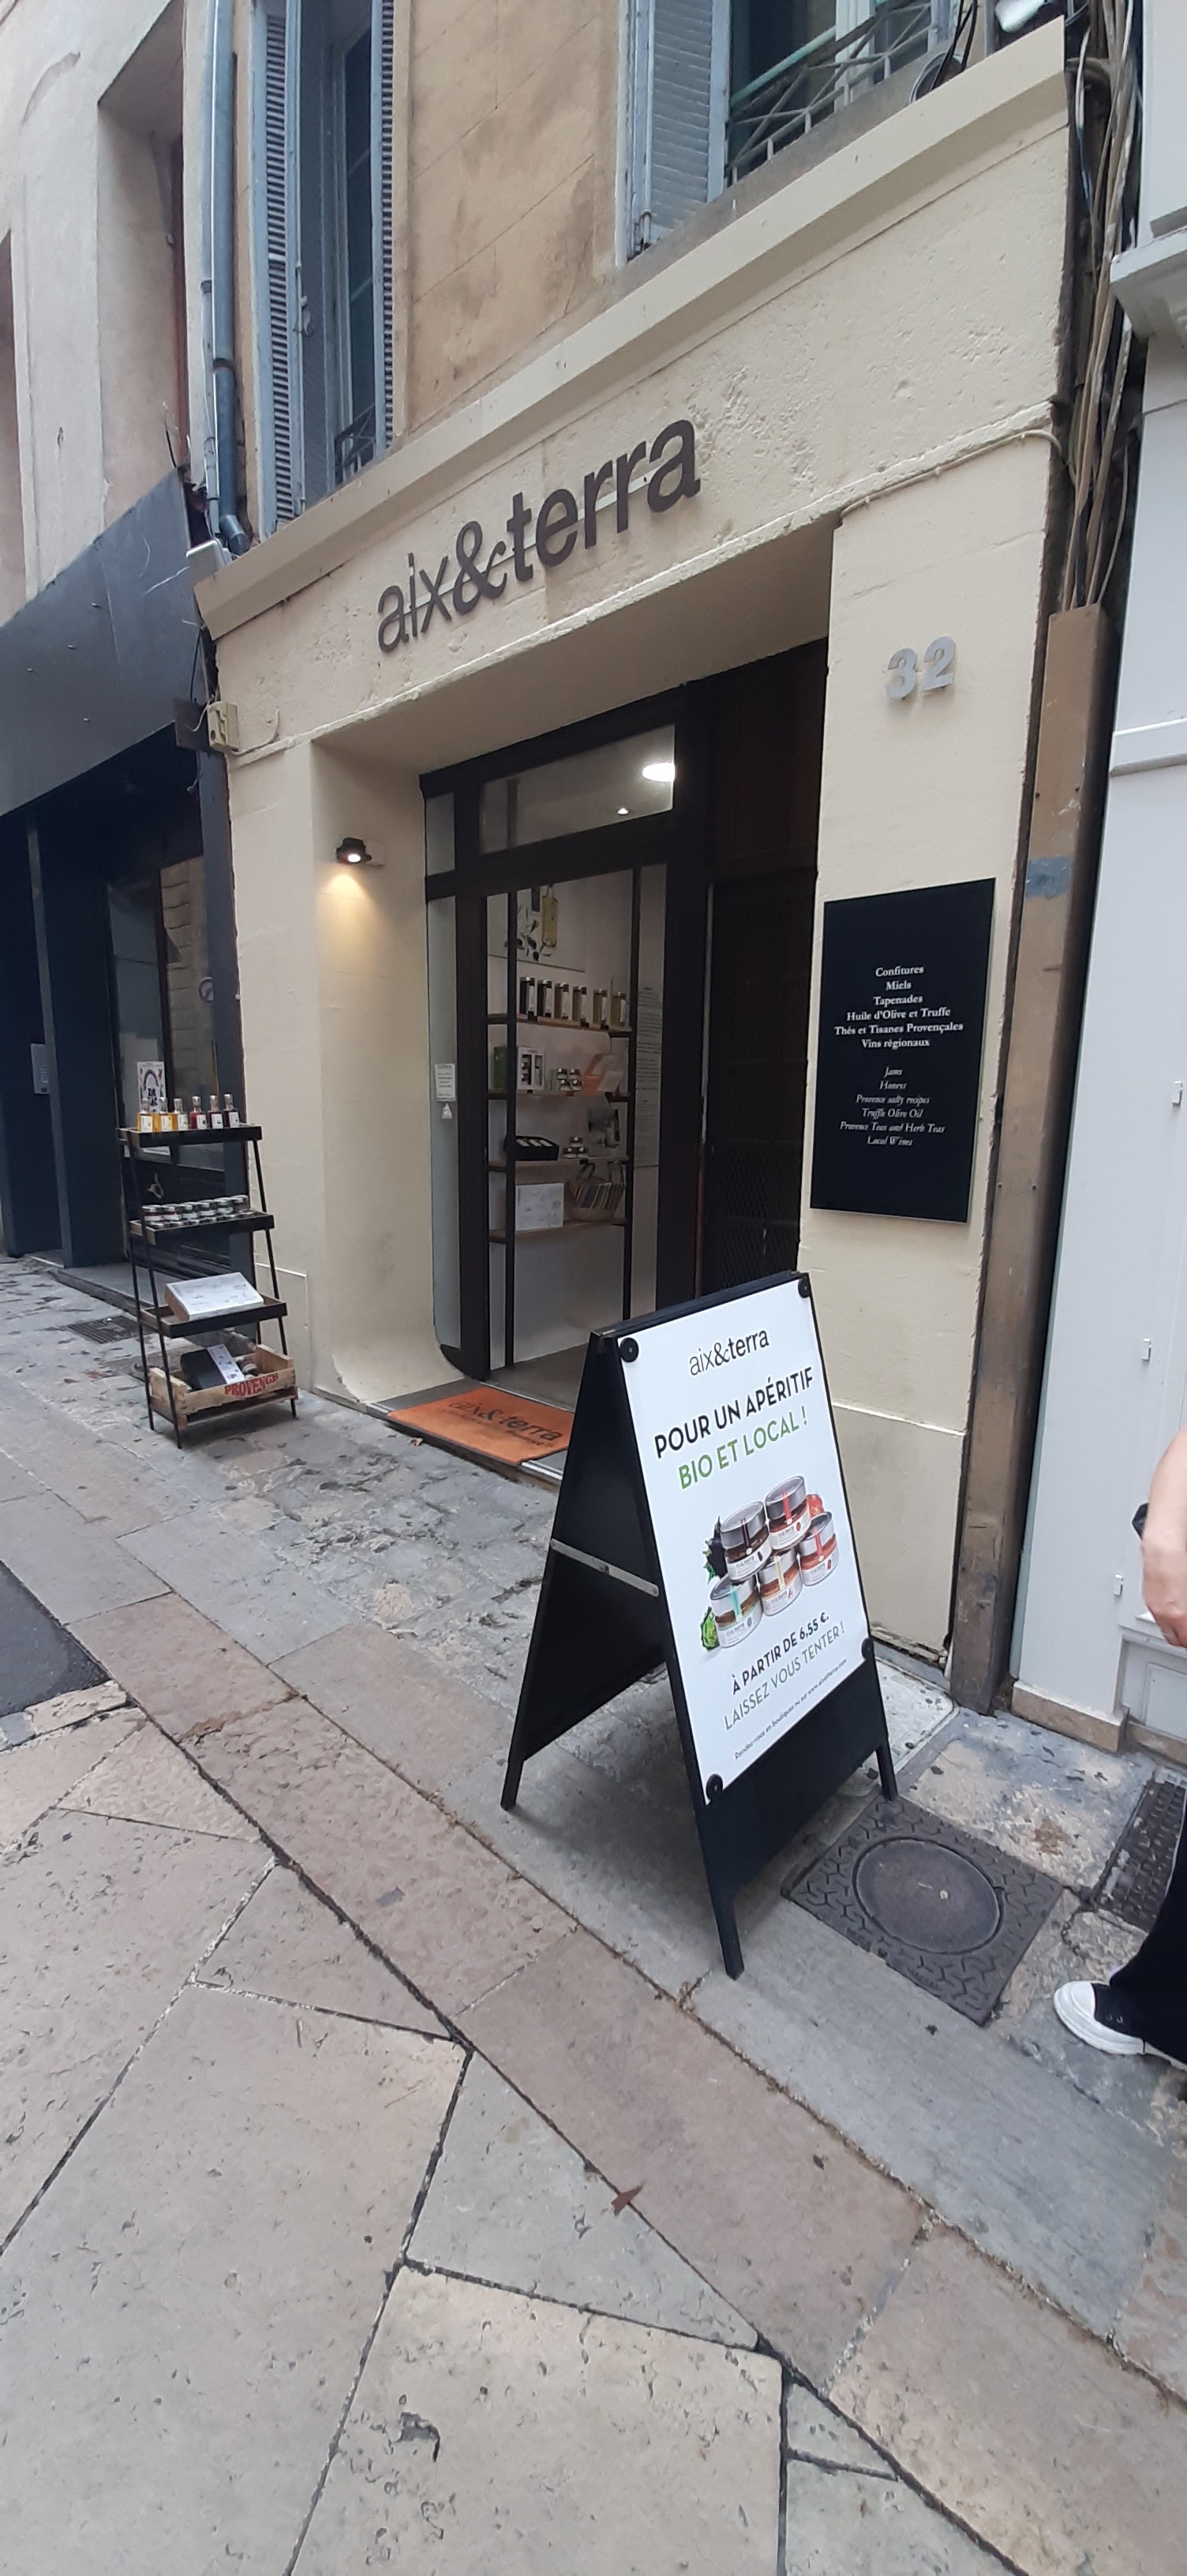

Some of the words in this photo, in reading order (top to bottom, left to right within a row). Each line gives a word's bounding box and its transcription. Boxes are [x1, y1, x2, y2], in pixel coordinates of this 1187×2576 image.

[378, 419, 701, 653] aix&terra
[886, 636, 956, 699] 32
[875, 965, 924, 977] Confitures
[886, 980, 912, 990] Miels
[873, 994, 923, 1008] Tapenades
[847, 1011, 871, 1021] Huile
[874, 1009, 906, 1020] d'Olive
[920, 1007, 951, 1017] Truffe
[834, 1026, 856, 1035] Thés
[869, 1024, 904, 1034] Tisanes
[907, 1022, 964, 1034] Provençales
[862, 1039, 882, 1048] Vins
[884, 1038, 931, 1050] régionaux
[906, 1095, 930, 1106] recipes
[862, 1108, 886, 1119] Truffle
[887, 1109, 907, 1118] Olive
[909, 1109, 923, 1118] Oil
[905, 1123, 925, 1133] Herb
[927, 1124, 945, 1133] Teas
[867, 1136, 888, 1144] Local
[889, 1136, 913, 1145] Wines
[689, 1330, 769, 1376] aix&terra
[654, 1415, 711, 1458] POUR
[713, 1399, 741, 1429] UN
[746, 1366, 813, 1417] APÉRITIF
[678, 1455, 713, 1489] BIO
[717, 1439, 738, 1470] ET
[743, 1411, 799, 1456] LOCAL
[732, 1673, 741, 1695] À
[742, 1645, 782, 1686] PARTIR
[783, 1631, 798, 1653] DE
[799, 1619, 818, 1641] 6,55
[724, 1682, 770, 1731] LAISSEZ
[770, 1657, 801, 1689] VOUS
[802, 1626, 840, 1664] TENTER
